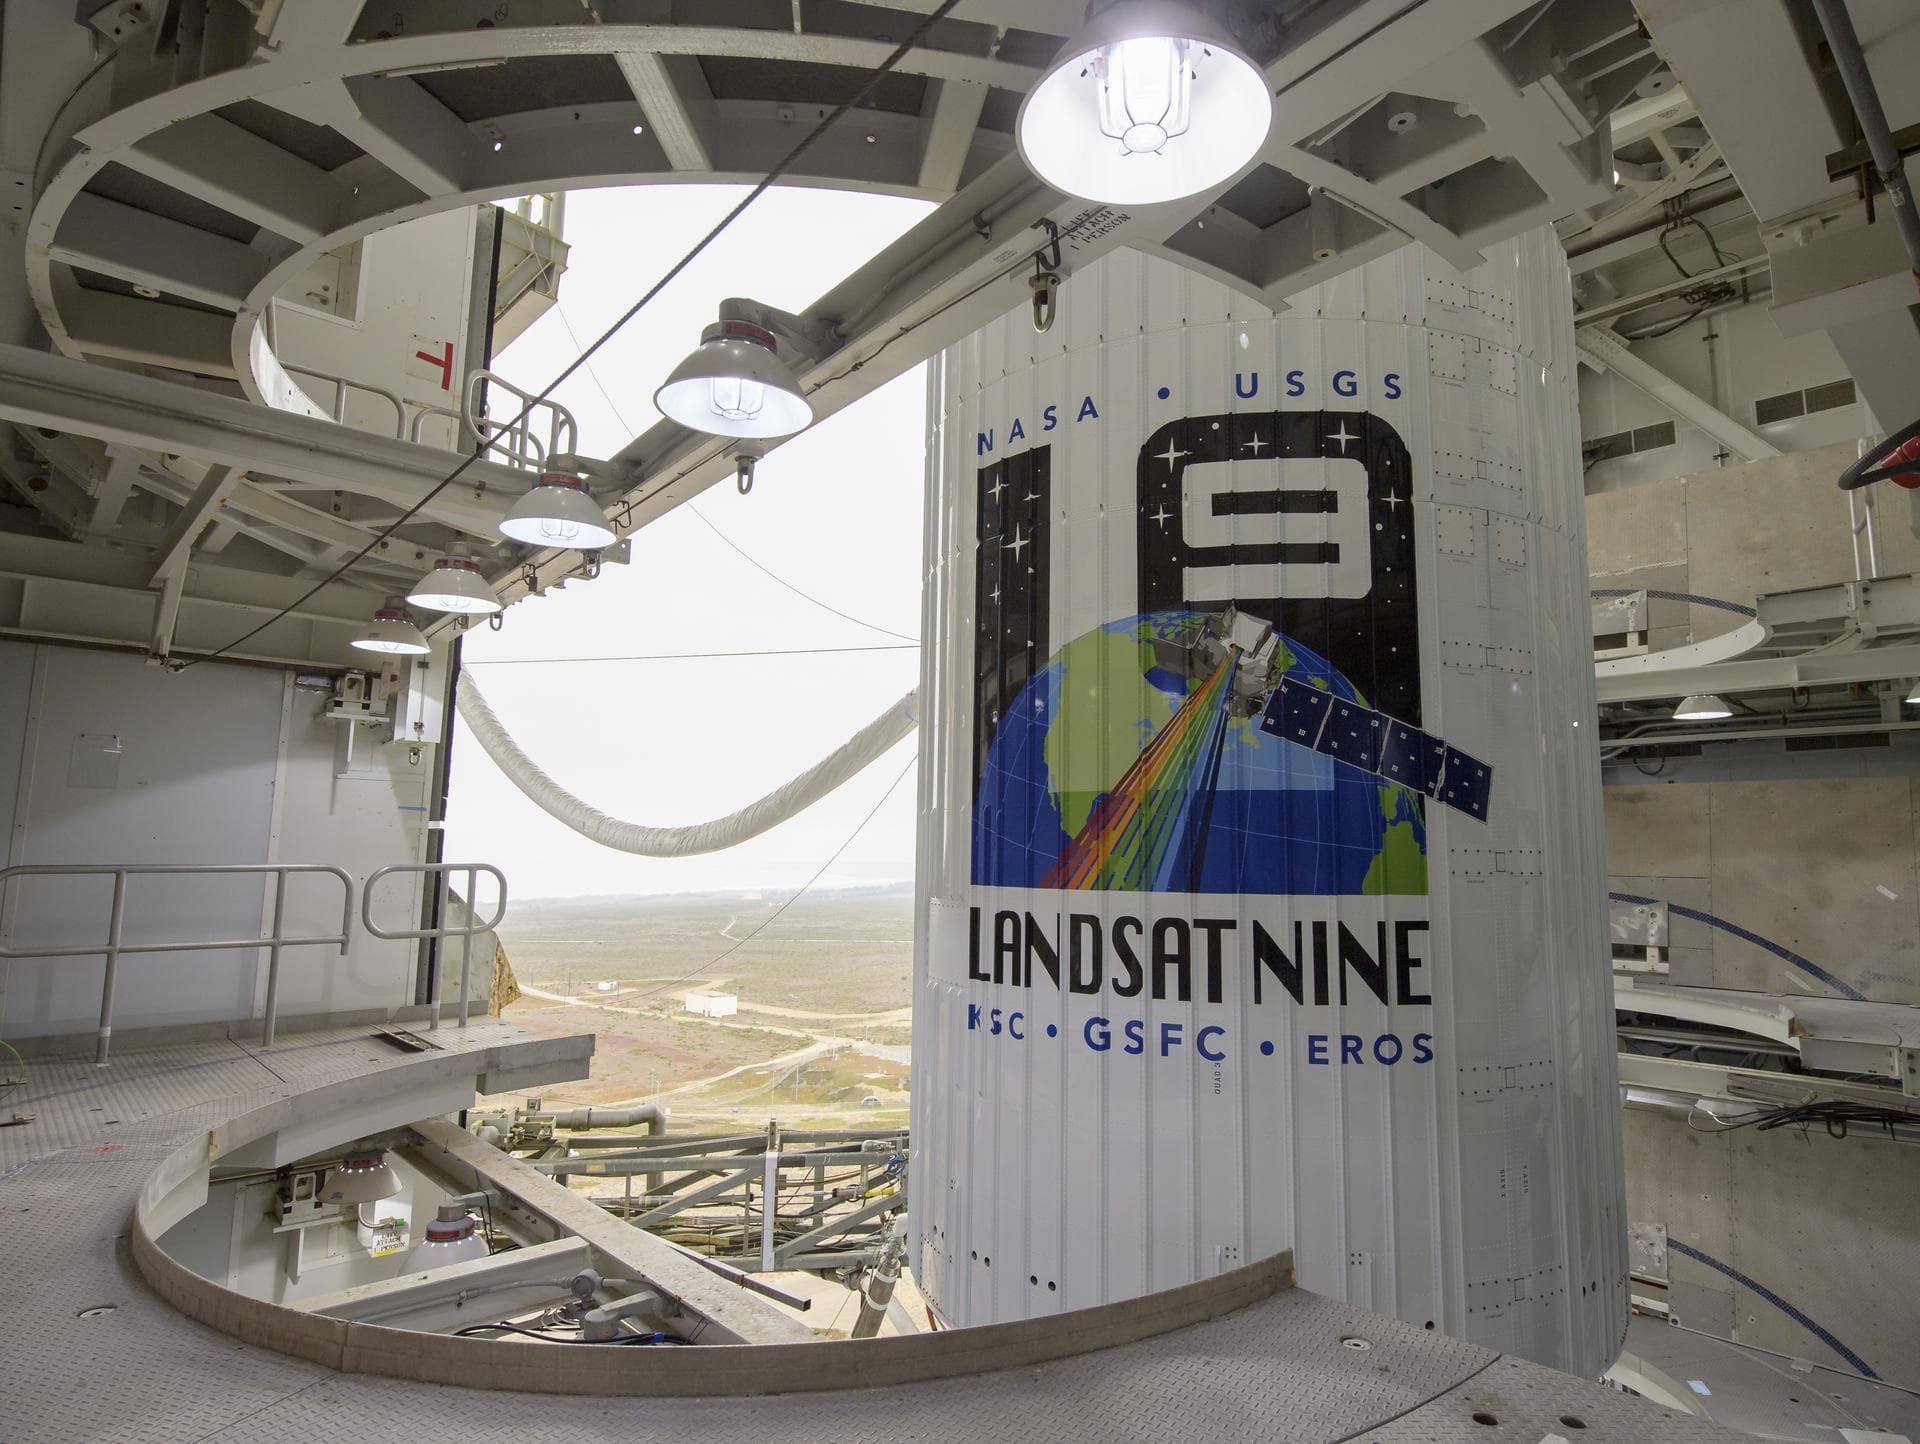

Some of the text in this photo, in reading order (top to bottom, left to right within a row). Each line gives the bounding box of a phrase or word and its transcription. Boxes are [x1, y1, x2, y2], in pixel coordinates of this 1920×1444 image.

[1081, 213, 1132, 243] PERSON
[976, 370, 1403, 456] NASA USGS
[968, 906, 1433, 1007] LANDSAT NINE
[968, 1004, 1434, 1066] KSC GSFC EROS
